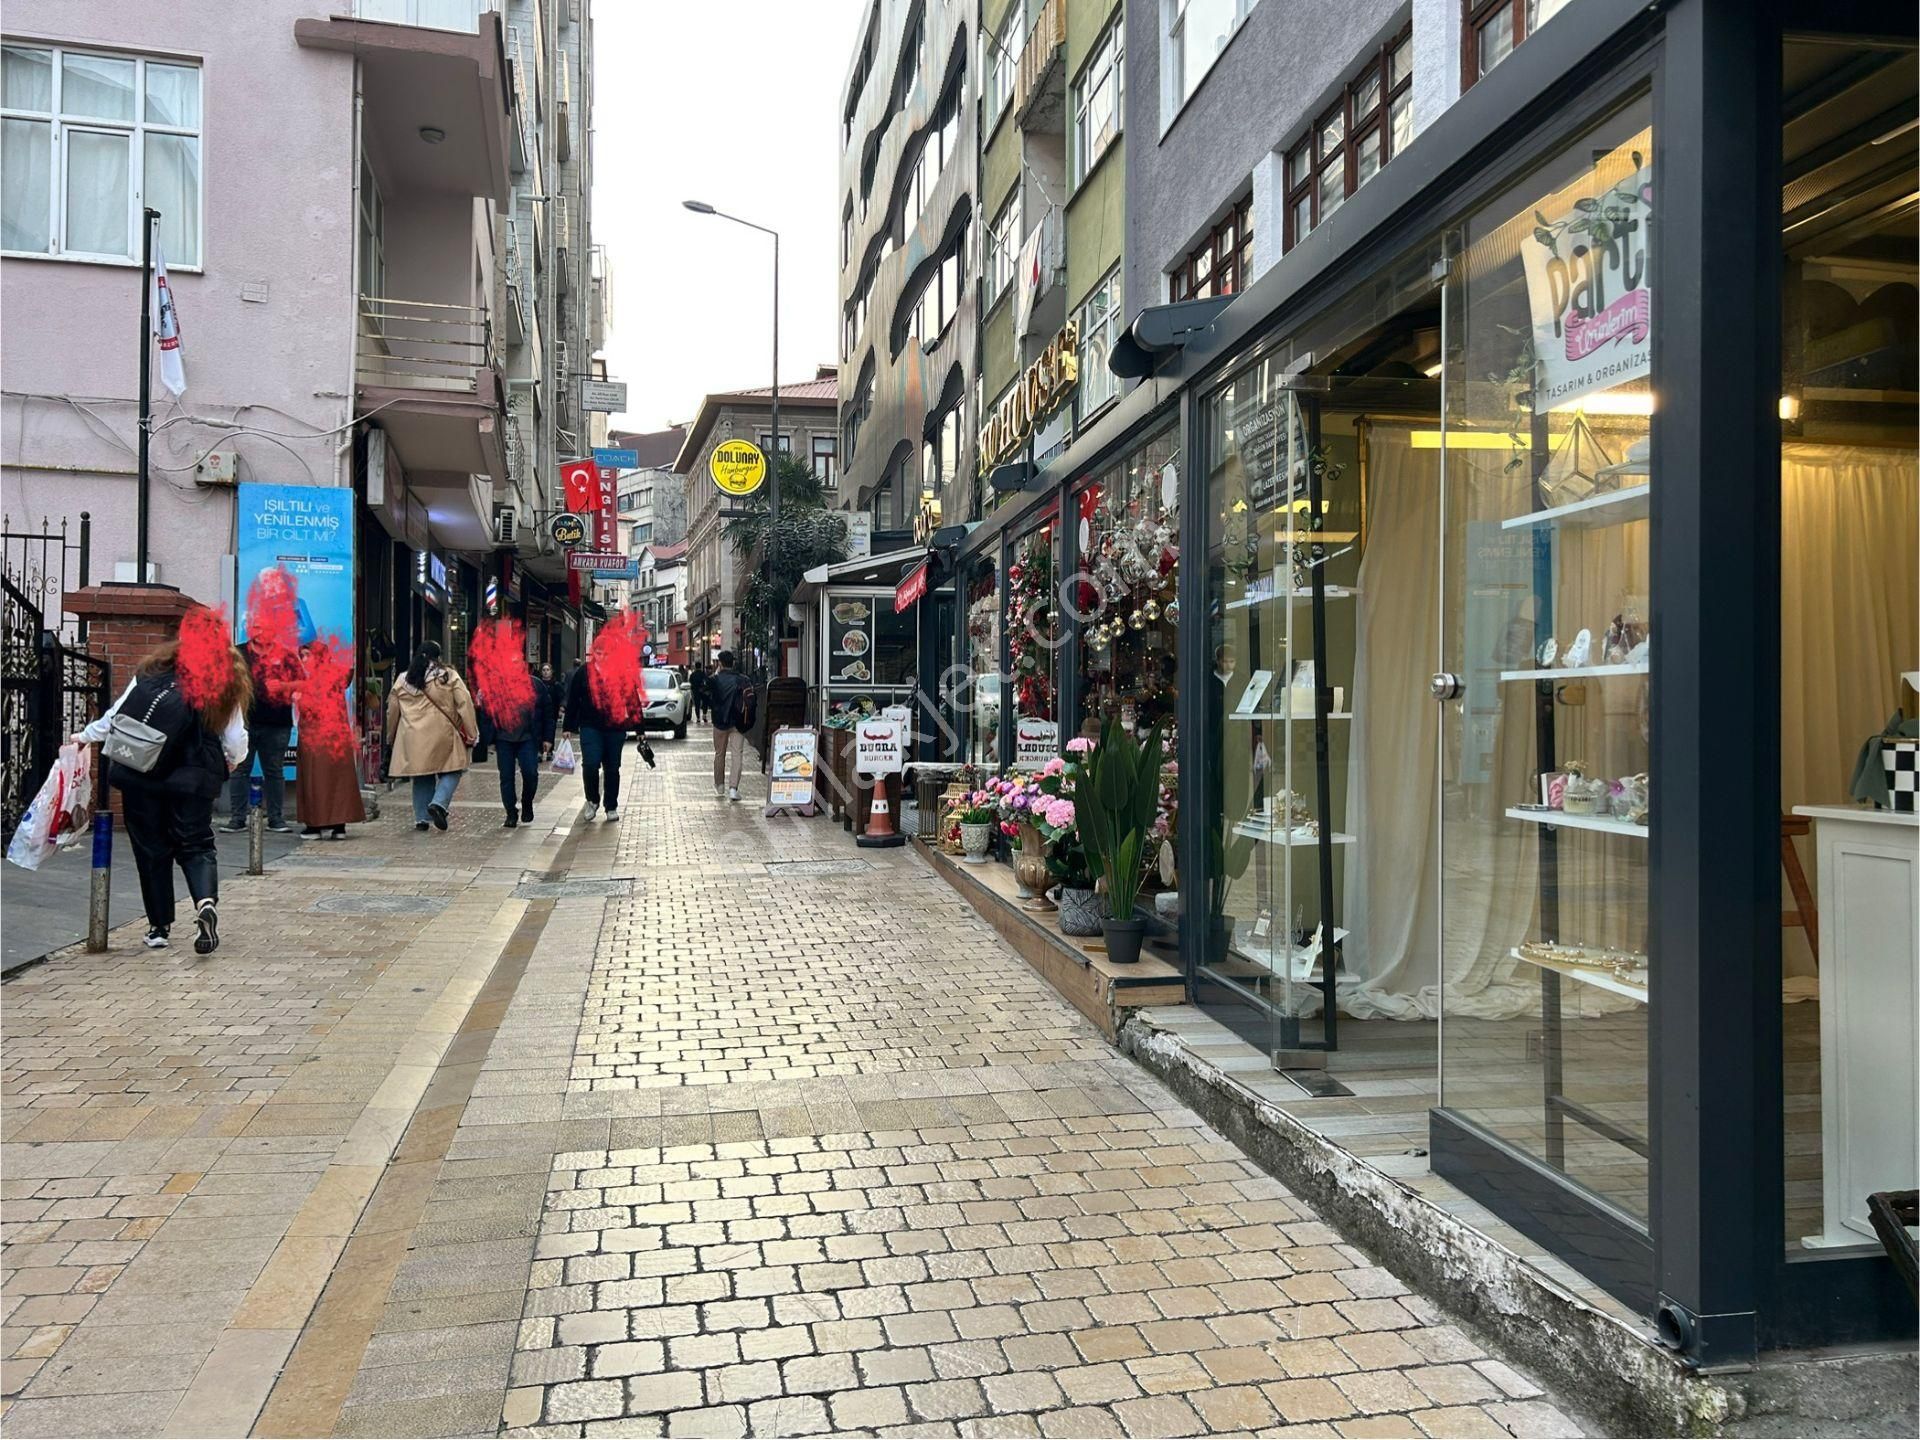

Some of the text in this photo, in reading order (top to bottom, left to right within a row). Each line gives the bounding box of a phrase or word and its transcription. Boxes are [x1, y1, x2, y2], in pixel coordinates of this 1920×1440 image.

[1546, 376, 1584, 400] TASARIM
[1587, 372, 1593, 385] &
[264, 499, 312, 513] IŞILTILI
[254, 512, 340, 531] YENİLENMİŞ
[573, 556, 598, 569] ANKARA
